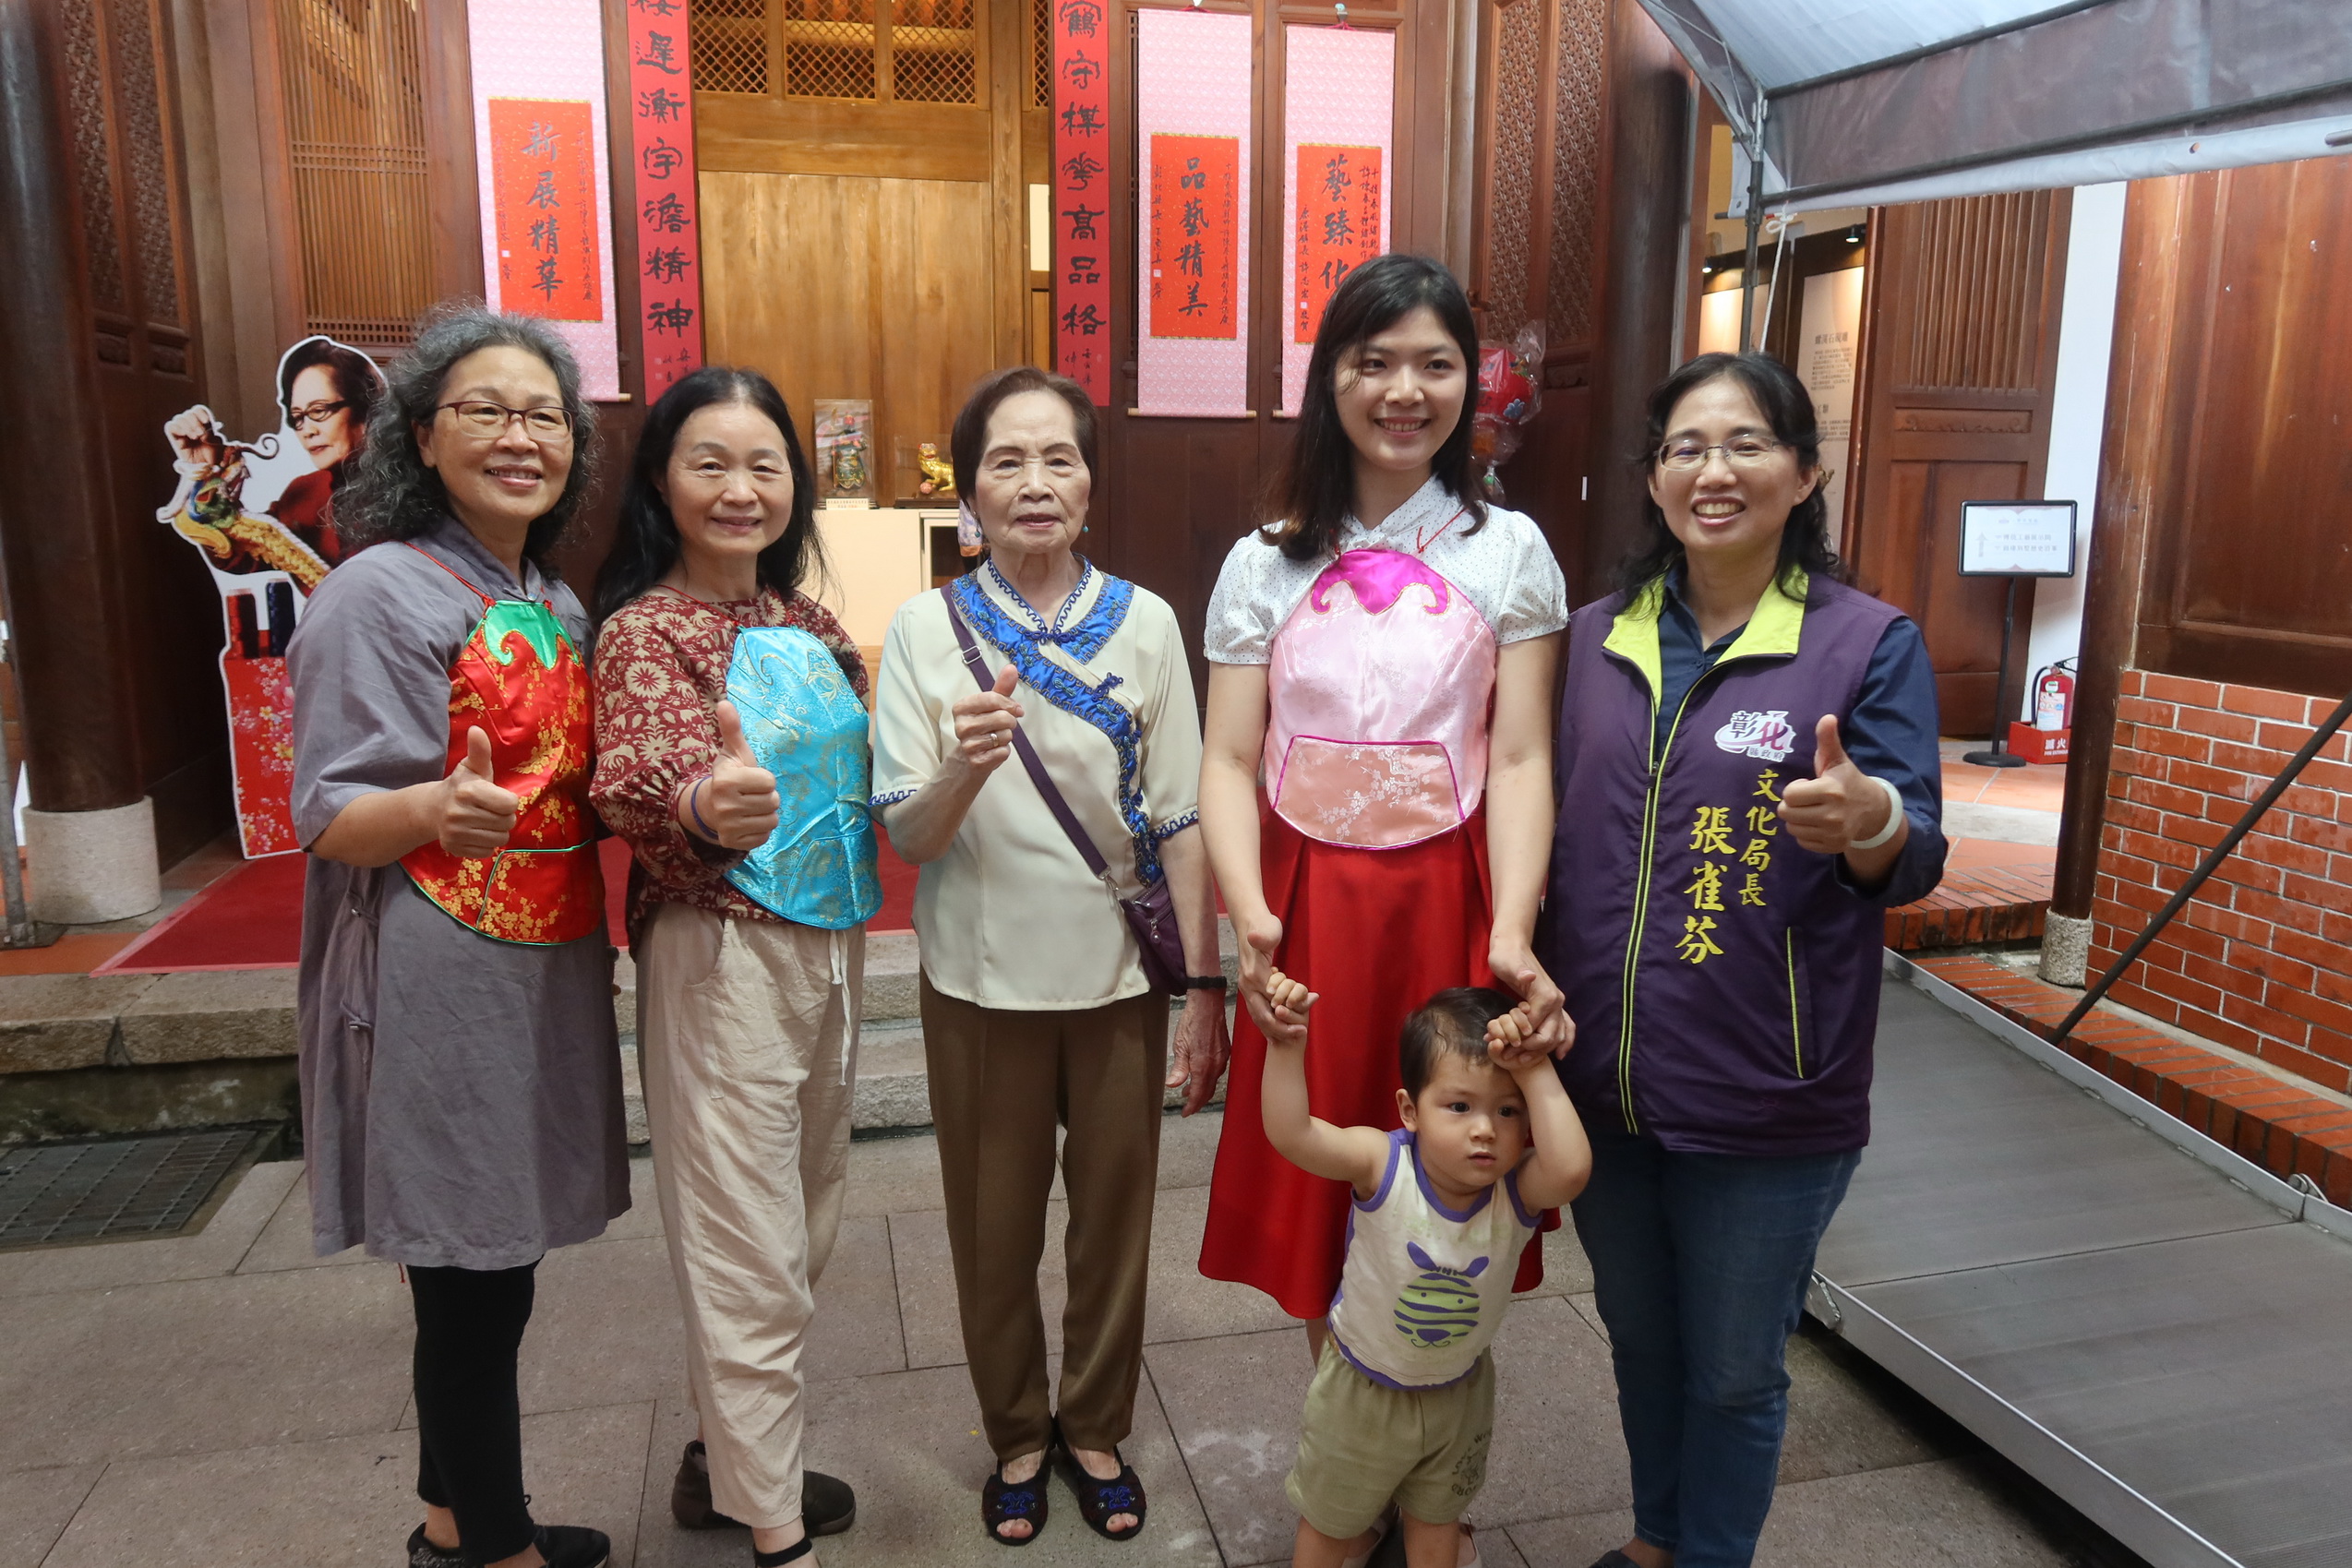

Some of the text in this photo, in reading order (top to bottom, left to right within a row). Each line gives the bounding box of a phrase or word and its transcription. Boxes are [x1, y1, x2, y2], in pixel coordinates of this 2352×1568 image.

[521, 121, 565, 303] 新展精華
[1174, 156, 1209, 318] 品藝精美
[1319, 153, 1355, 316] 藝臻化
[1730, 712, 1787, 750] 彰化
[1674, 806, 1737, 964] 張雀芬
[1738, 768, 1782, 906] 文化局長
